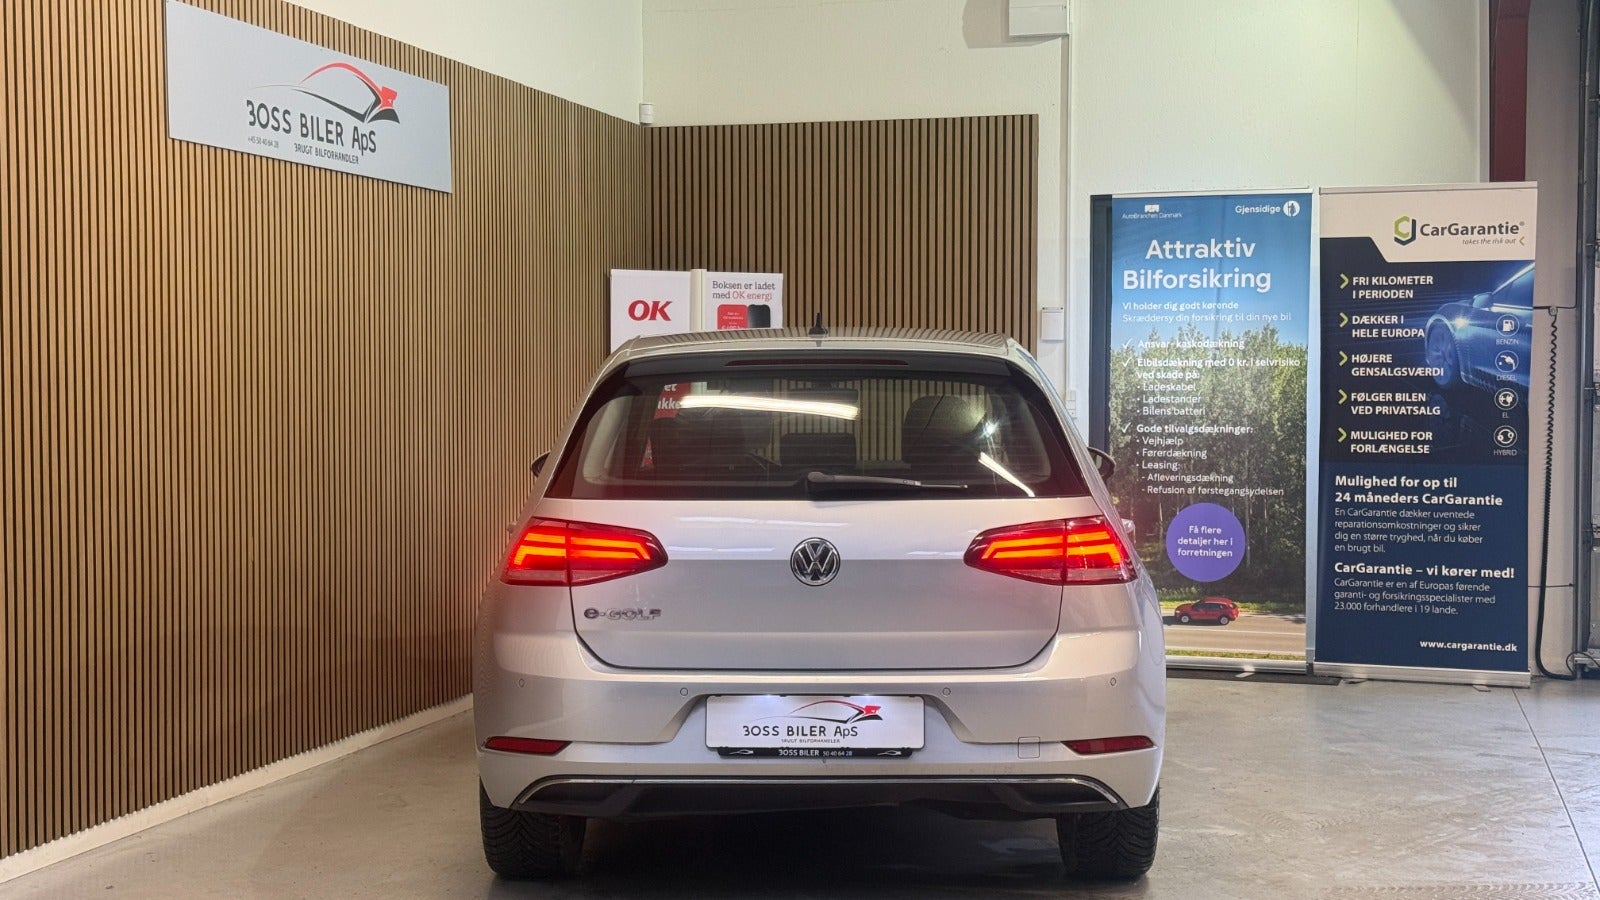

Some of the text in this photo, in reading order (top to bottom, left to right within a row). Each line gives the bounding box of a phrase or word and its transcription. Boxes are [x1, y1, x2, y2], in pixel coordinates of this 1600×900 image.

[300, 113, 344, 146] BILER
[352, 126, 376, 156] ApS
[315, 147, 359, 164] BILFORHANDLER
[1235, 205, 1280, 215] Gjensidige
[1145, 237, 1256, 259] Attraktiv
[712, 281, 775, 290] Boksen er ladet
[1123, 268, 1271, 293] Bilforsikring
[1353, 276, 1433, 286] FRI KILOMETER
[712, 291, 772, 302] med OK energi
[1353, 289, 1414, 299] I PERIODEN
[628, 300, 672, 321] OK
[1123, 302, 1238, 312] Vi holder dig godt kørende
[1123, 312, 1291, 324] Skræddersy din forsikring til din nye bil
[1352, 315, 1404, 324] DÆKKER I
[1352, 328, 1425, 338] HELE EUROPA
[1176, 340, 1245, 349] kaskodækning
[1137, 358, 1203, 368] Elbilsdækning
[1205, 359, 1226, 367] med
[1237, 358, 1248, 367] kr.
[1250, 359, 1254, 367] i
[1256, 358, 1300, 367] selvrisiko
[1352, 354, 1393, 364] HØJERE
[1137, 370, 1200, 381] ved skade på:
[1352, 367, 1444, 377] GENSALGSVÆRDI
[1143, 383, 1196, 391] Ladeskabel
[1142, 395, 1201, 404] Ladestander
[1351, 392, 1426, 402] FØLGER BILEN
[1142, 407, 1206, 416] Bilens batteri
[1351, 406, 1440, 415] VED PRIVATSALG
[1137, 424, 1253, 435] Gode tilvalgsdækninger:
[1142, 436, 1184, 446] Vejhjælp
[1351, 431, 1433, 441] MULIGHED FOR
[1142, 449, 1207, 459] Førerdækning
[1351, 444, 1430, 454] FORLÆNGELSE
[1142, 461, 1180, 471] Leasing:
[1147, 473, 1234, 483] Afleveringsdækning
[1336, 475, 1457, 490] Mulighed for op til
[1147, 486, 1284, 497] Refusion af førstegangsydelsen
[1335, 492, 1503, 506] 24 måneders CarGarantie
[1335, 508, 1475, 519] En CarGarantie dækker uventede
[1189, 525, 1222, 534] Få flere
[1335, 520, 1481, 532] reparationsomkostninger og sikrer
[1178, 537, 1234, 546] detaljer her i
[1335, 532, 1348, 541] dig
[1364, 533, 1388, 541] større
[1390, 534, 1426, 544] tryghed,
[1428, 534, 1441, 543] når
[1444, 534, 1455, 543] du
[1458, 535, 1483, 544] køber
[1178, 548, 1233, 559] forretningen
[1335, 544, 1385, 553] en brugt bil.
[1334, 562, 1413, 575] CarGarantie
[1426, 565, 1438, 575] vi
[1442, 566, 1477, 577] kører
[1481, 567, 1515, 578] med!
[1334, 578, 1384, 588] CarGarantie
[1410, 580, 1419, 589] af
[1420, 581, 1453, 591] Europas
[1456, 581, 1490, 591] førende
[1334, 591, 1496, 604] garanti- og forsikringsspecialister med
[1334, 602, 1362, 611] 23.000
[1364, 602, 1413, 612] forhandlere
[1420, 605, 1430, 613] 19
[1432, 604, 1458, 614] lande.
[1420, 640, 1518, 652] www.cargarantie.dk
[787, 726, 826, 737] BILER
[835, 726, 858, 739] ApS
